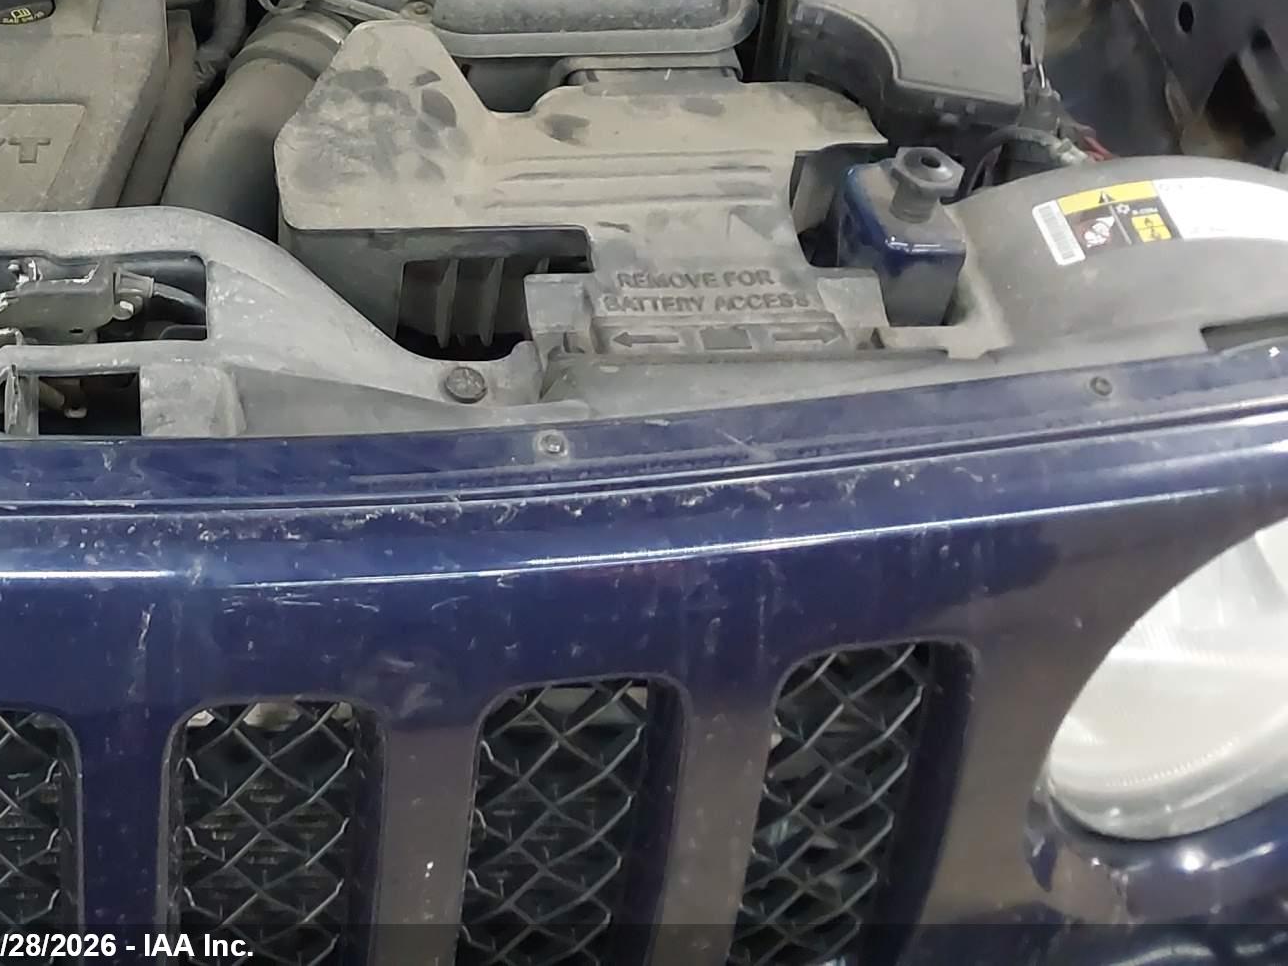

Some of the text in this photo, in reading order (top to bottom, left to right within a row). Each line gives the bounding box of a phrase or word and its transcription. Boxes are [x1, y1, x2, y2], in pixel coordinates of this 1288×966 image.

[616, 269, 775, 289] REMOVE FOR
[603, 292, 809, 312] BATTERY ACCESS
